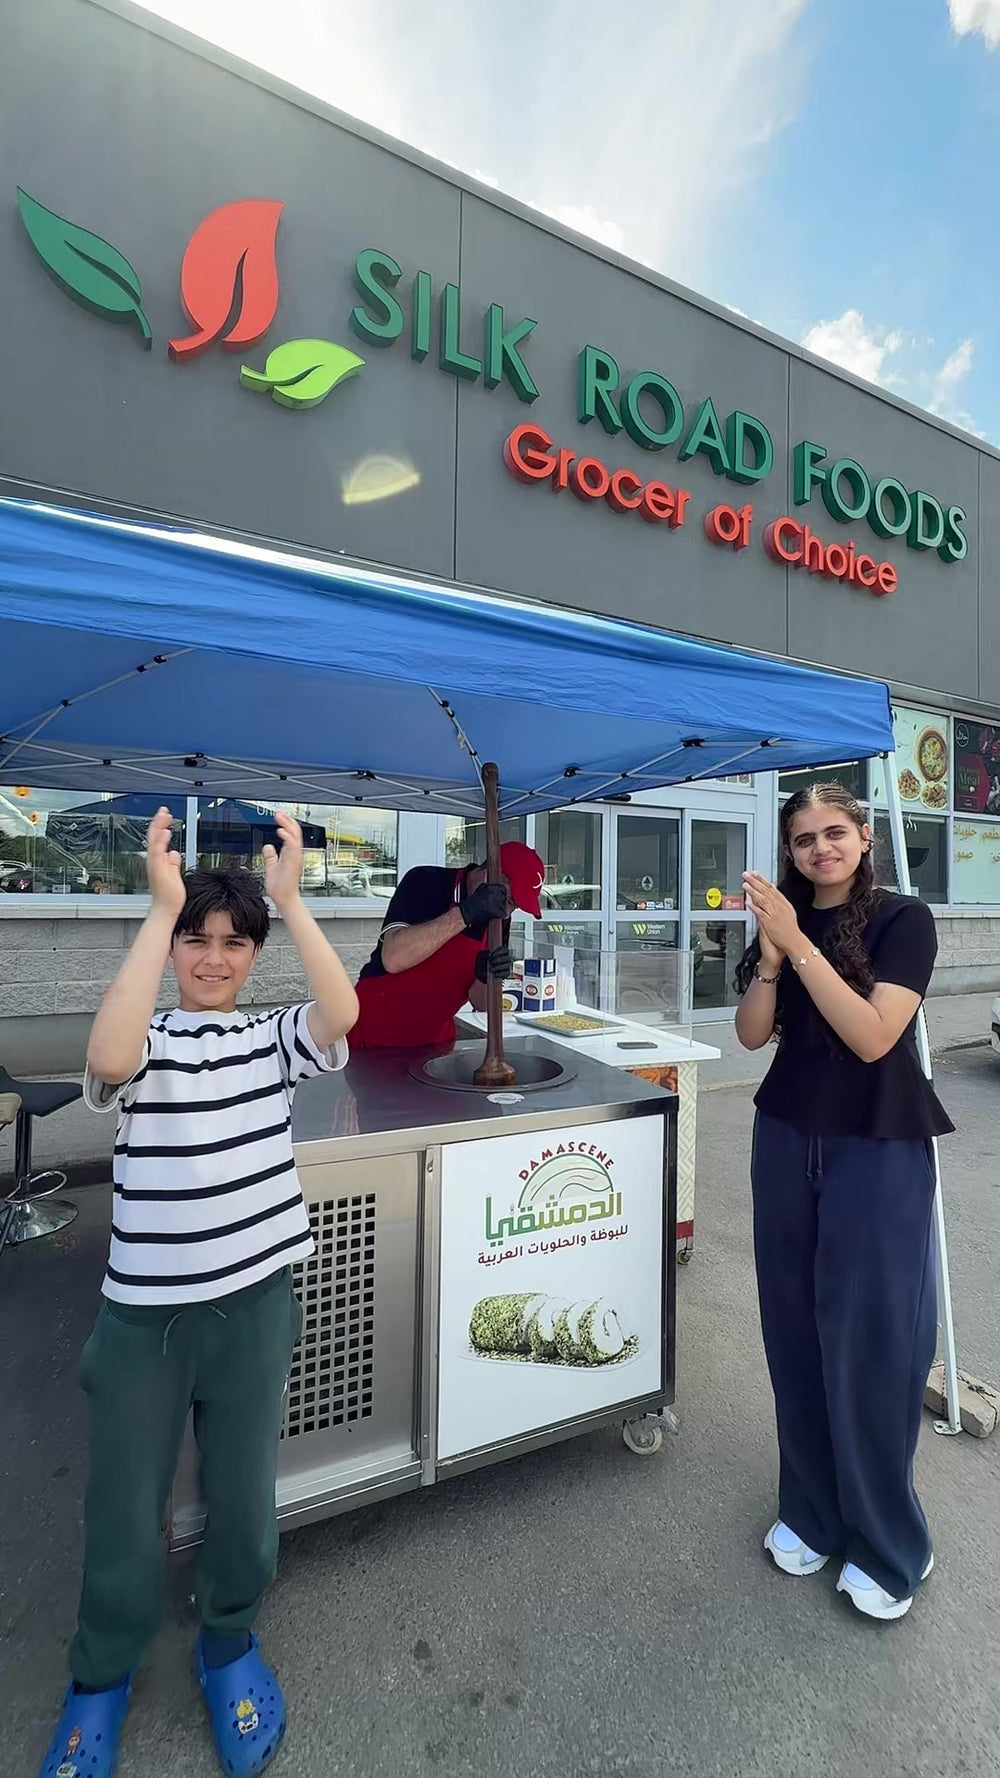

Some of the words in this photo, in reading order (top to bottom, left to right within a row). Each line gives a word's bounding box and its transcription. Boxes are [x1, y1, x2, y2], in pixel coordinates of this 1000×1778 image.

[350, 248, 540, 404] SILK
[577, 344, 774, 485] ROAD
[794, 440, 968, 563] FOODS
[503, 423, 692, 529] Grocer
[704, 504, 754, 551] of
[764, 516, 899, 595] Choice
[518, 1141, 614, 1181] DAMASCENE
[527, 1234, 587, 1255] والحلويات
[590, 1225, 629, 1241] للبوظة
[477, 1245, 523, 1267] العربية
